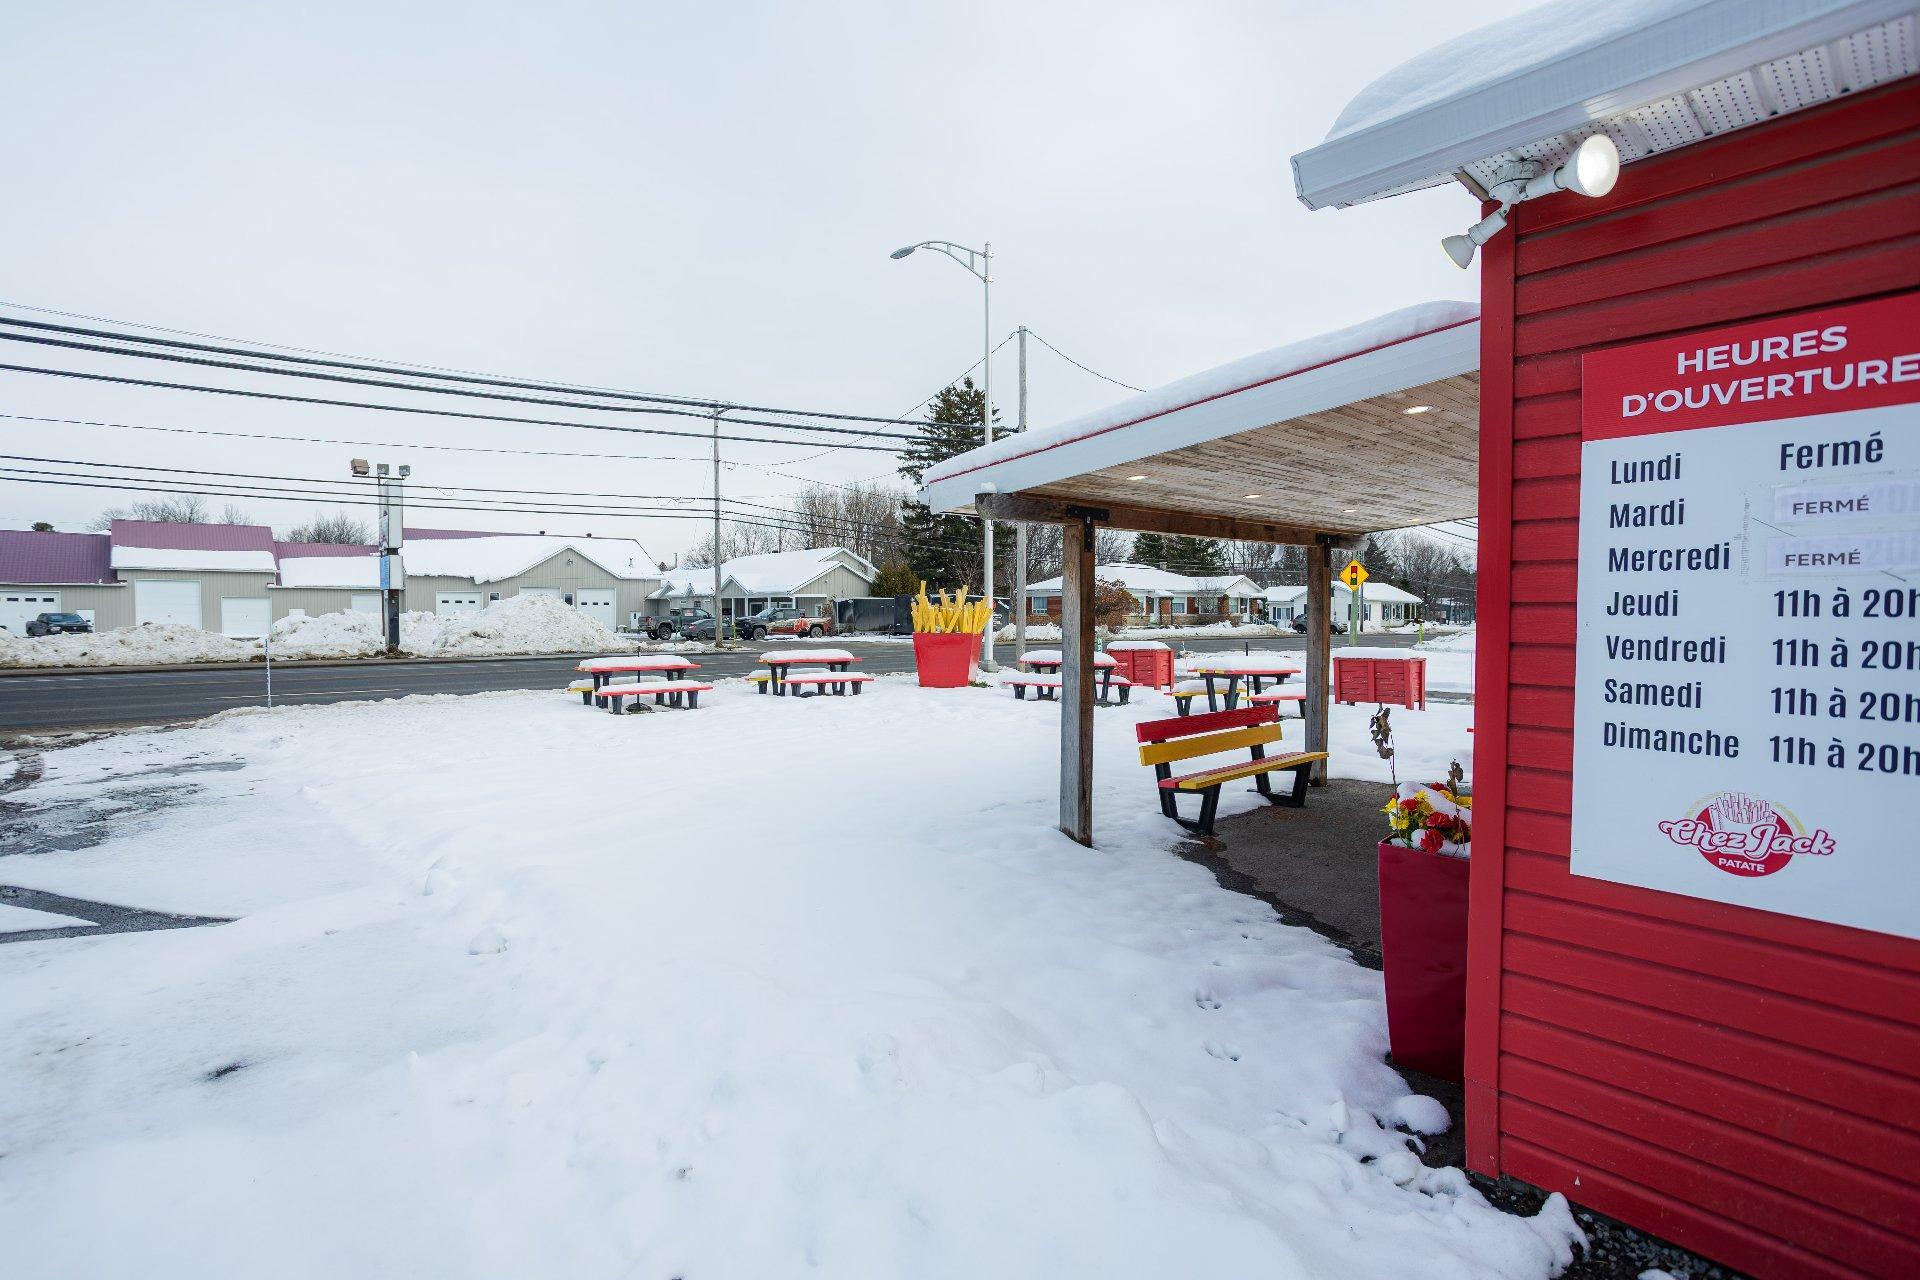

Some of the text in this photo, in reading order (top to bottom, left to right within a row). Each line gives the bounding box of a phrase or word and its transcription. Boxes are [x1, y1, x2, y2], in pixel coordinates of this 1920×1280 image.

[1677, 325, 1848, 375] HEURES
[1611, 431, 1884, 485] Lundi Fermé
[1609, 498, 1685, 529] Mardi
[1792, 494, 1869, 516] FERMÉ
[1608, 542, 1730, 573] Mercredi
[1784, 548, 1861, 567] FERMÉ
[1606, 590, 1678, 617] Jeudi
[1773, 589, 1821, 618] 11h
[1831, 586, 1850, 618] à
[1605, 635, 1920, 671] Vendredi 11h à 20h
[1604, 678, 1920, 724] Samedi 11h à 20h
[1603, 721, 1920, 776] Dimanche 11h à 20h
[1658, 819, 1836, 860] Chez Jack
[1718, 857, 1766, 873] PATATE
